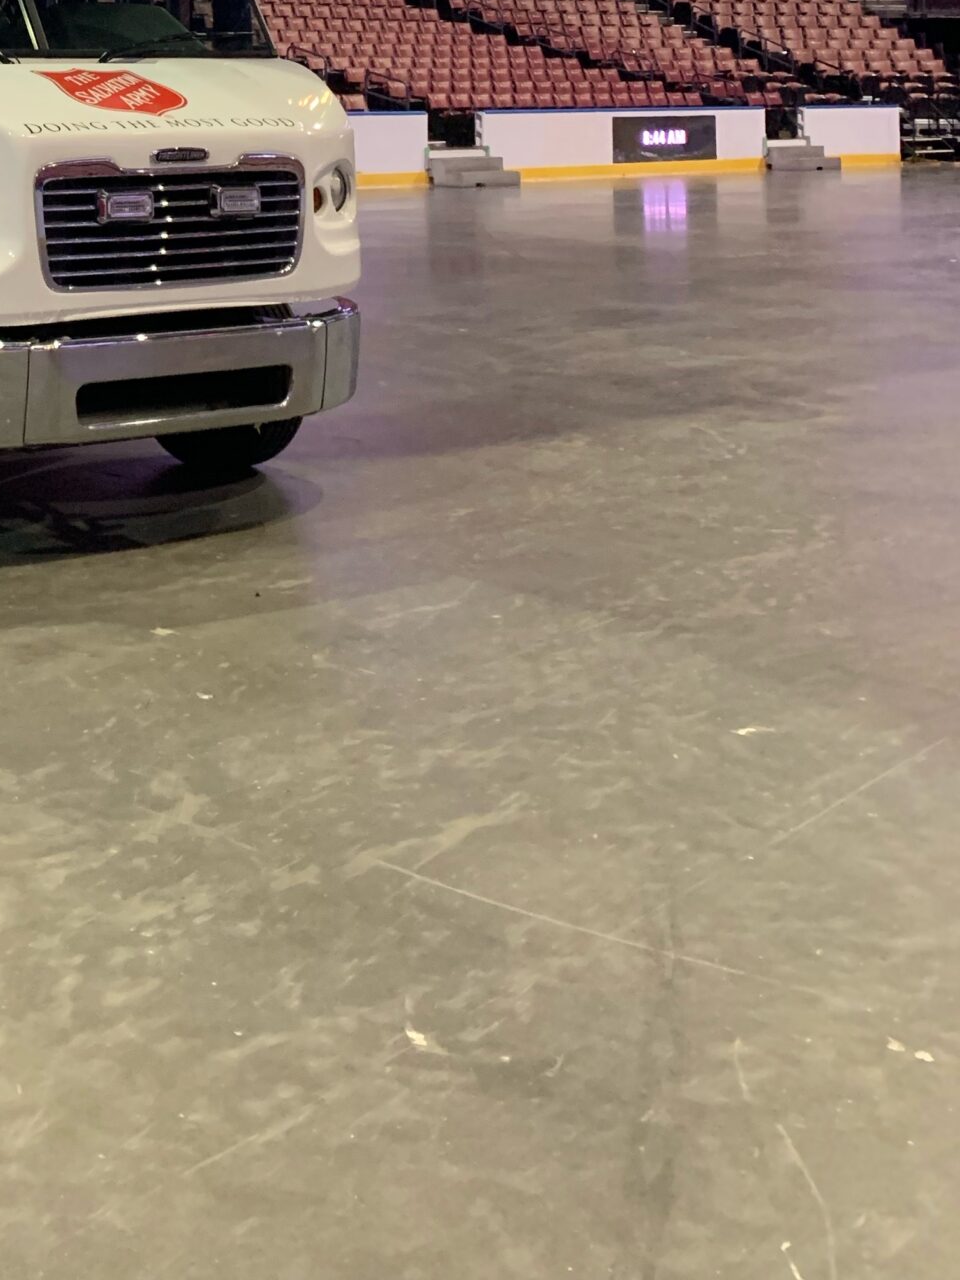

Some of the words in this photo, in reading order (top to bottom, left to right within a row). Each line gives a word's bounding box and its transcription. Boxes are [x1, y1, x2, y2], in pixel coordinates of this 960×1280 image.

[64, 71, 100, 86] THE
[75, 73, 142, 105] SALVATION
[119, 83, 161, 110] ARMY
[23, 121, 108, 135] DOING
[111, 120, 161, 129] THE
[167, 118, 225, 128] MOST
[230, 117, 296, 128] GOOD
